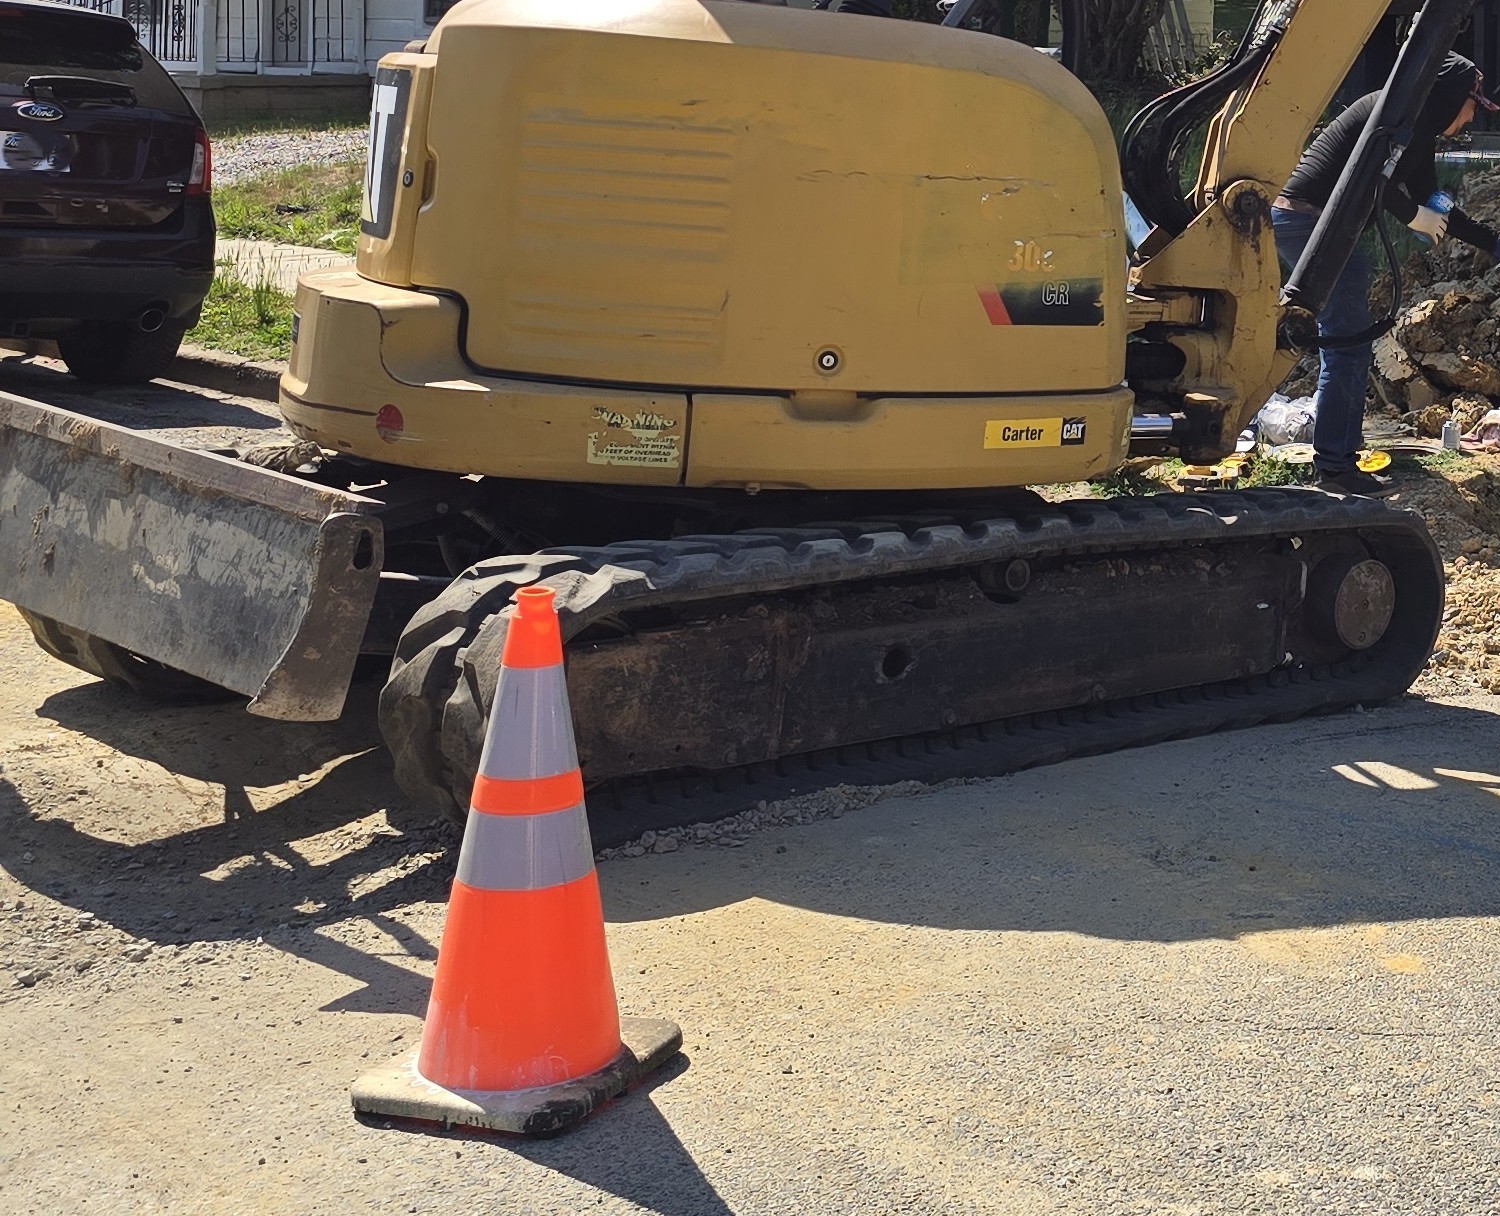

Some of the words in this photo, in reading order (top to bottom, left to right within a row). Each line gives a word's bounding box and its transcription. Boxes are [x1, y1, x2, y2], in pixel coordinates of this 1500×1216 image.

[28, 105, 55, 117] Ford
[1042, 281, 1070, 305] CR
[1002, 426, 1044, 441] Carter
[1062, 423, 1085, 439] CAT
